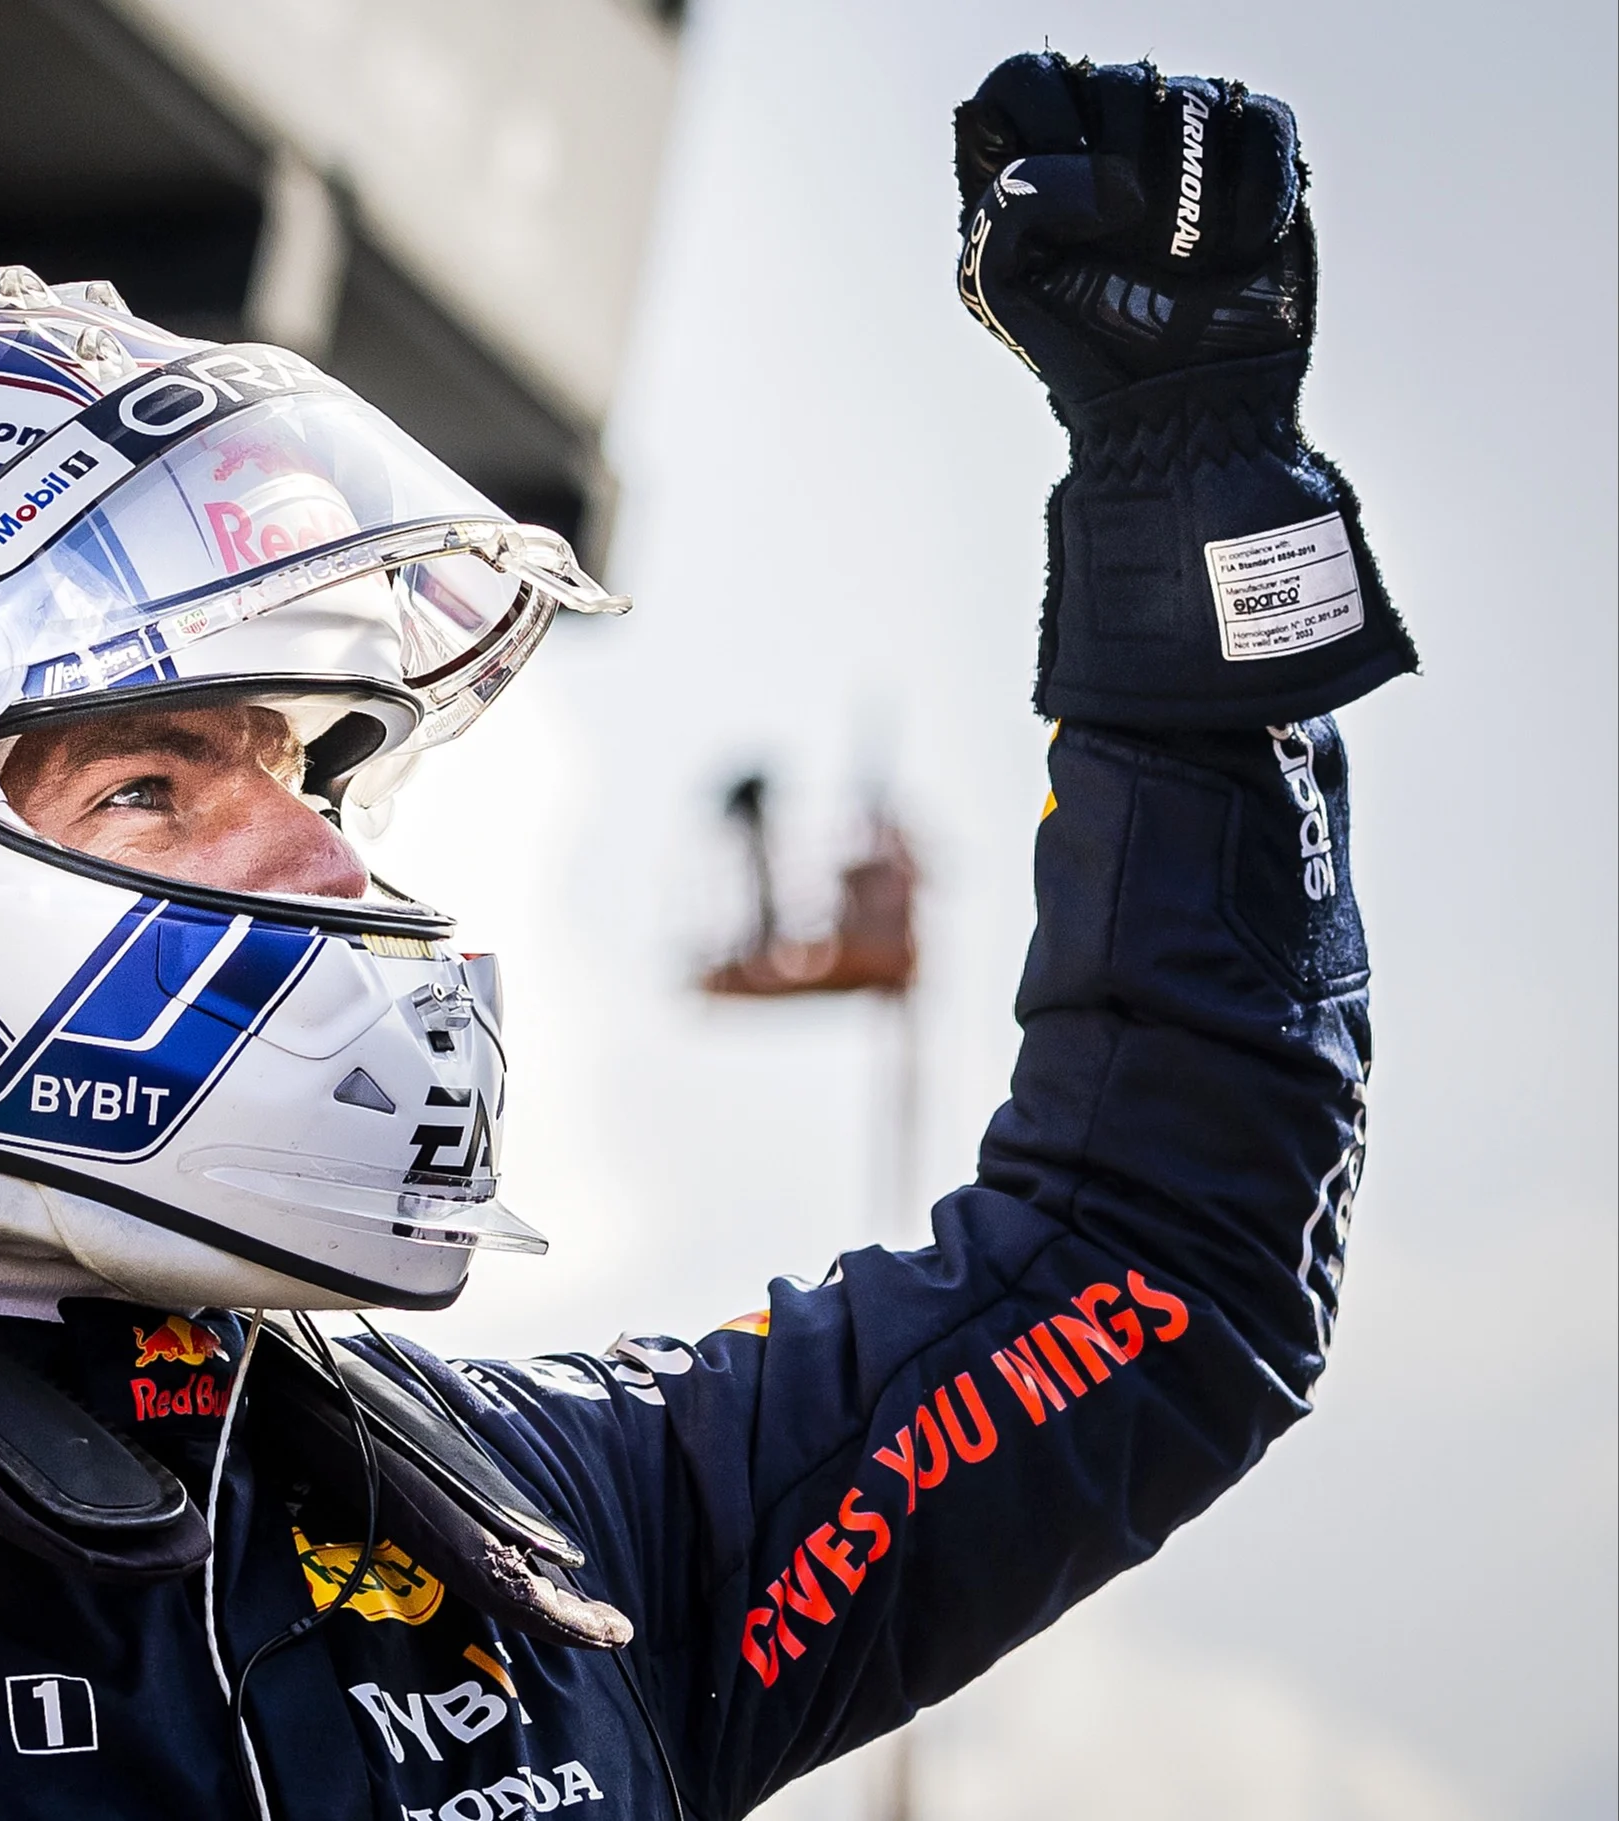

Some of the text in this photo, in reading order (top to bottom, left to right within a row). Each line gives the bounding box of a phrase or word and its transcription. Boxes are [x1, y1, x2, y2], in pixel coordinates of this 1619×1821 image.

[30, 1073, 170, 1126] BYBIT
[130, 1373, 193, 1422] Red
[740, 1269, 1189, 1689] GIVES YOU WINGS
